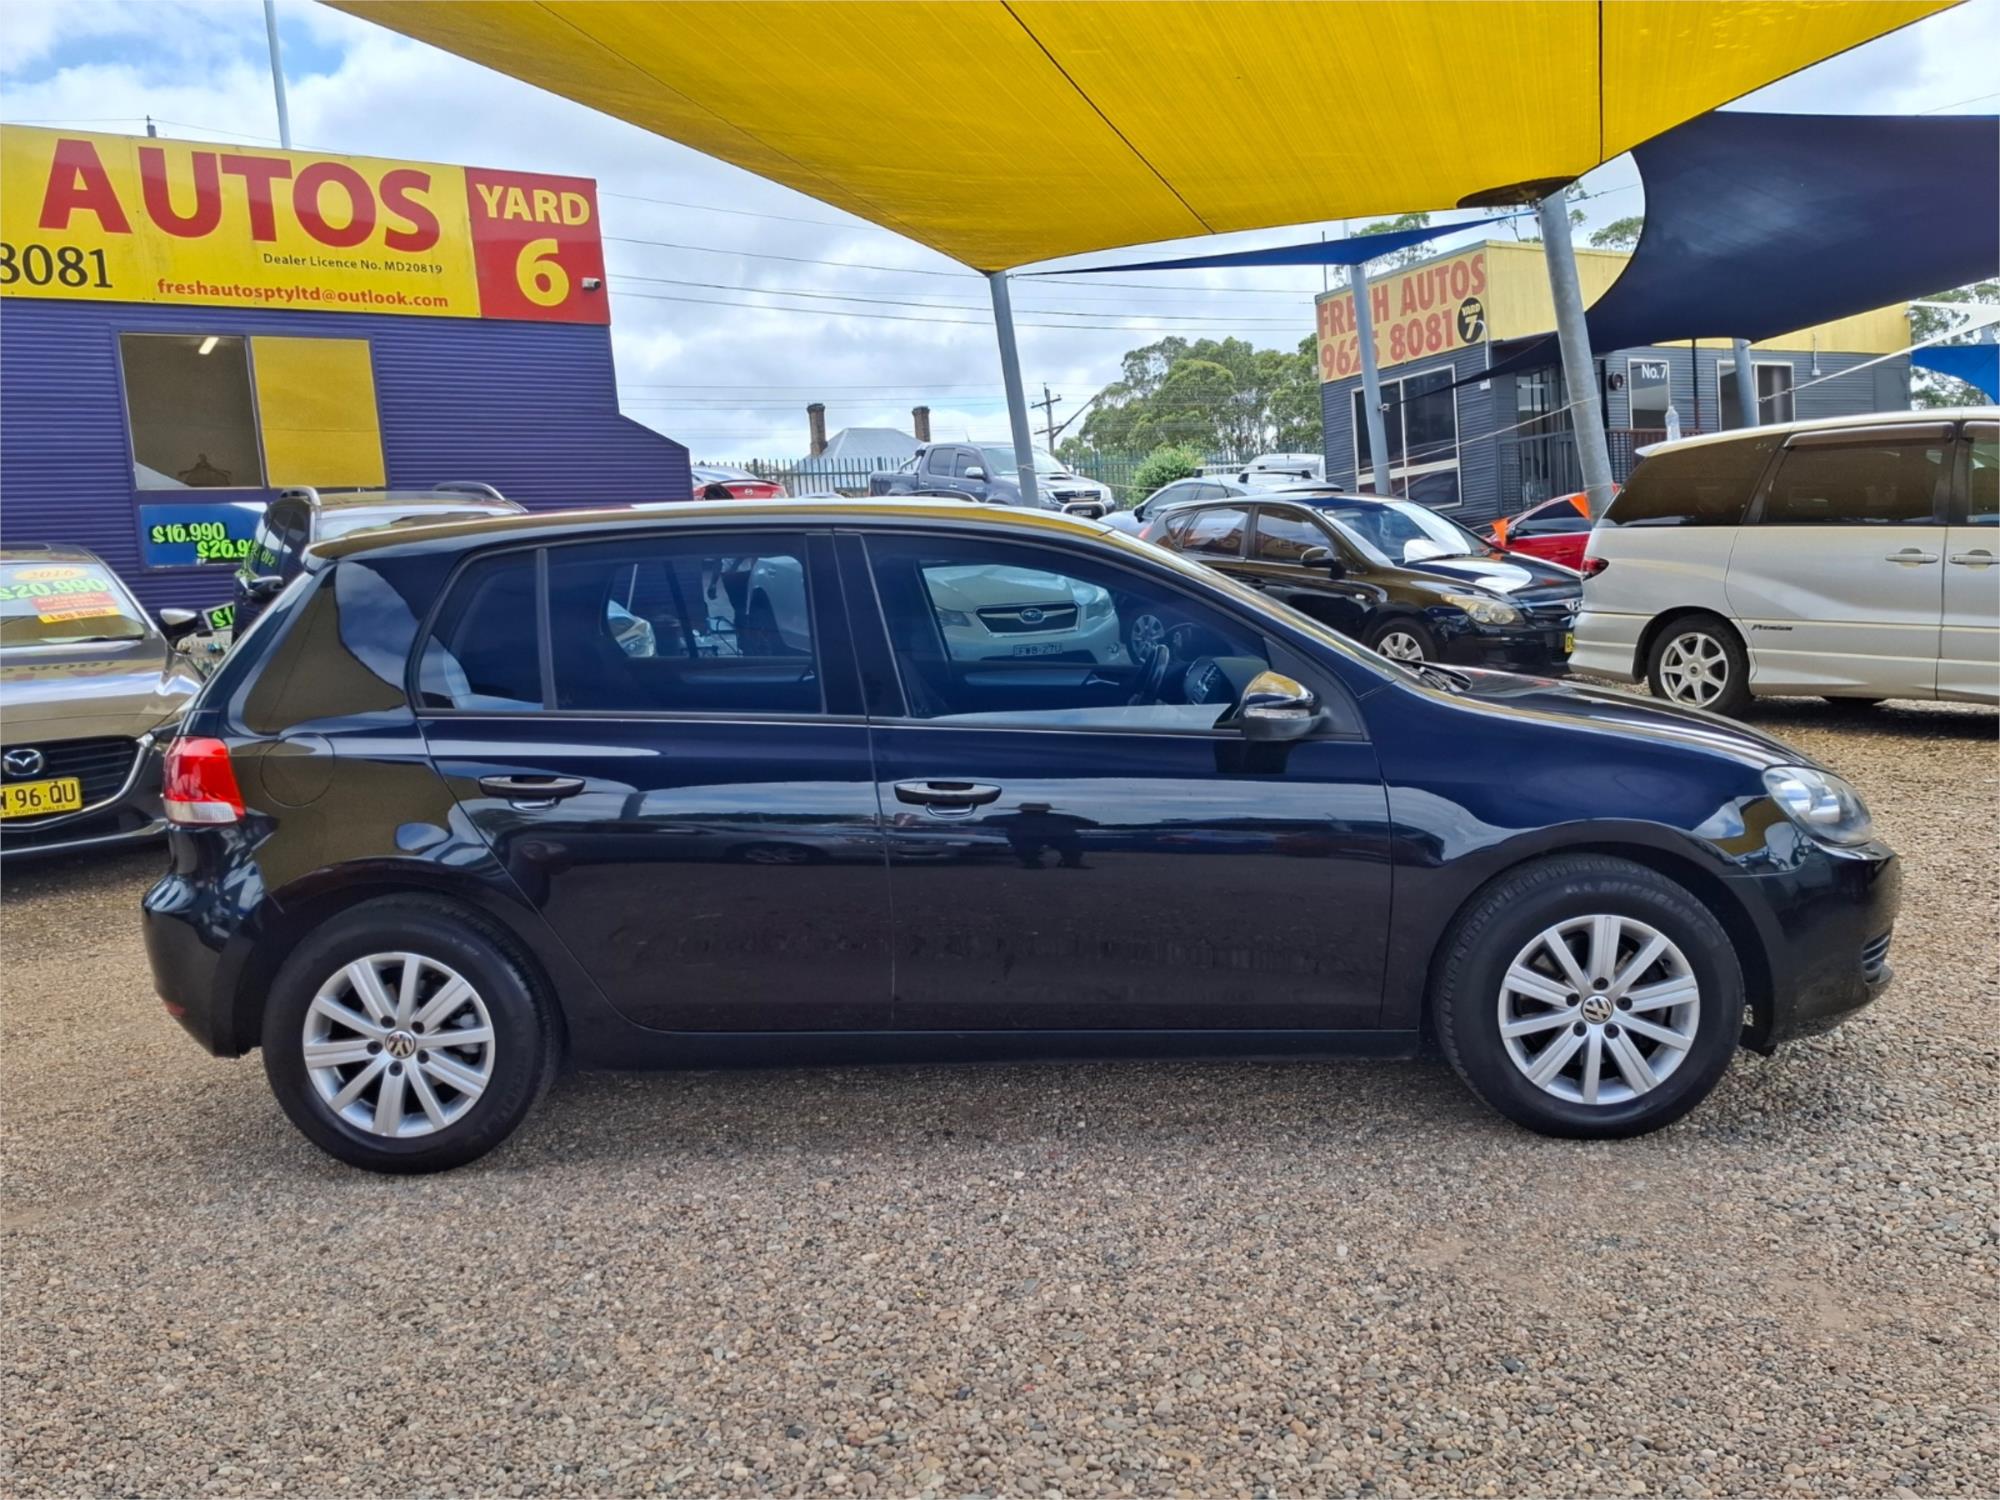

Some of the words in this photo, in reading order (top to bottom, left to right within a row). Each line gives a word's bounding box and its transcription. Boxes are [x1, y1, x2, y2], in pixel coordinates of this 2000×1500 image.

[38, 138, 441, 253] AUTOS
[475, 183, 591, 226] YARD
[0, 242, 113, 288] 8081
[263, 253, 307, 267] Dealer
[310, 257, 358, 269] Licence
[360, 259, 382, 271] No.
[384, 261, 443, 274] MD20819
[516, 237, 570, 307] 6
[157, 278, 449, 308] freshautosptyltd@outlook.com
[1317, 284, 1390, 341] FREH
[1400, 253, 1487, 317] AUTOS
[1461, 303, 1481, 317] YARD
[1389, 309, 1454, 362] 8081
[1464, 315, 1479, 340] 7
